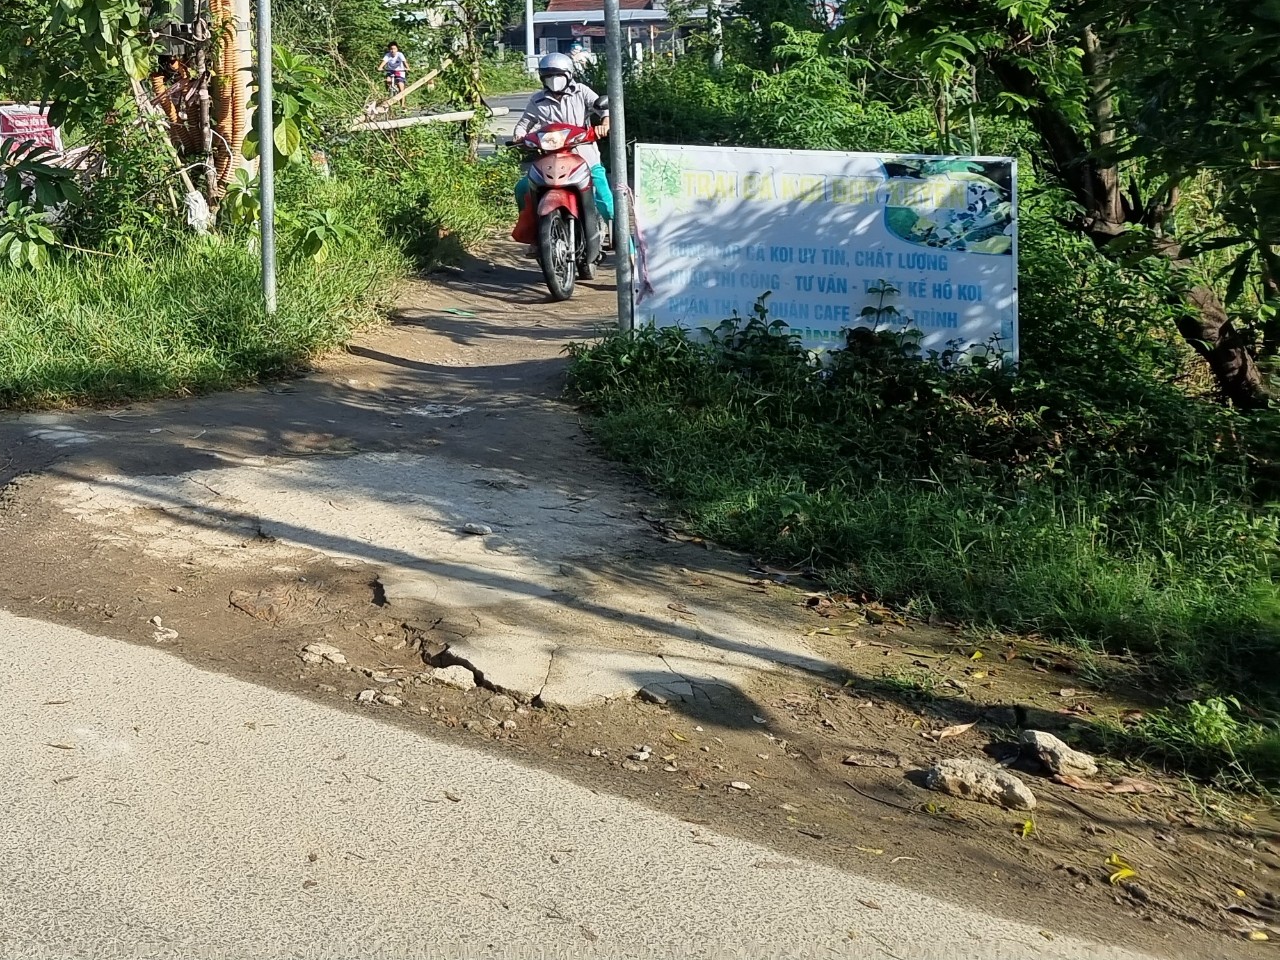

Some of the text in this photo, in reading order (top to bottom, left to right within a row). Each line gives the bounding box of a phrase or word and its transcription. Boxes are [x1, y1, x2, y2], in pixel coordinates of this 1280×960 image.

[770, 246, 794, 263] KOI
[799, 247, 817, 264] UY
[821, 246, 850, 267] TÍN,
[854, 246, 894, 268] CHẤT
[898, 251, 948, 273] LƯỢNG
[740, 269, 780, 290] CÔNG
[795, 274, 814, 291] TƯ
[817, 271, 848, 294] VẤN
[908, 276, 927, 298] KẾ
[957, 284, 983, 301] KOI
[814, 304, 850, 322] CAFE
